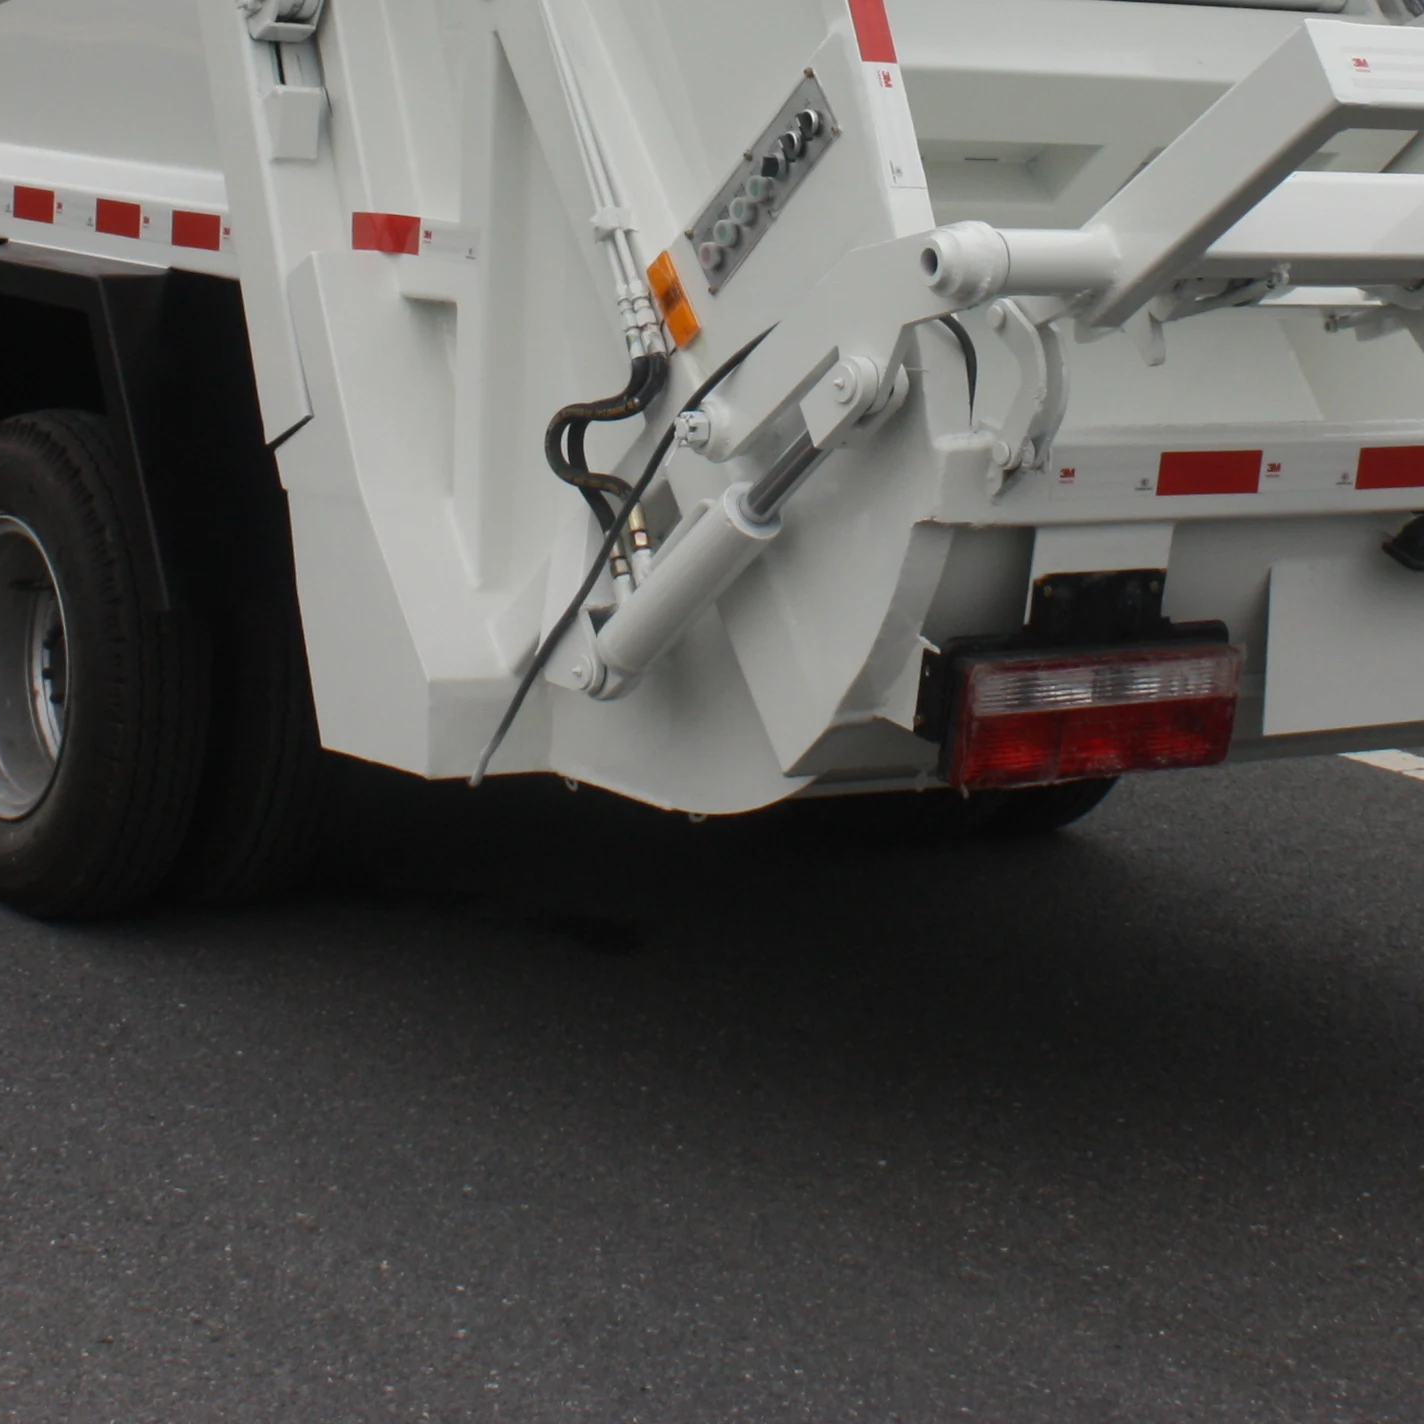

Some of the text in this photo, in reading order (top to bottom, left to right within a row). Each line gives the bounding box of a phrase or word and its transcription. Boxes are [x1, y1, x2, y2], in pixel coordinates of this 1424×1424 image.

[1352, 57, 1369, 68] 3M
[881, 70, 893, 88] 3M
[1266, 462, 1281, 472] 3M
[1059, 468, 1075, 478] 3M
